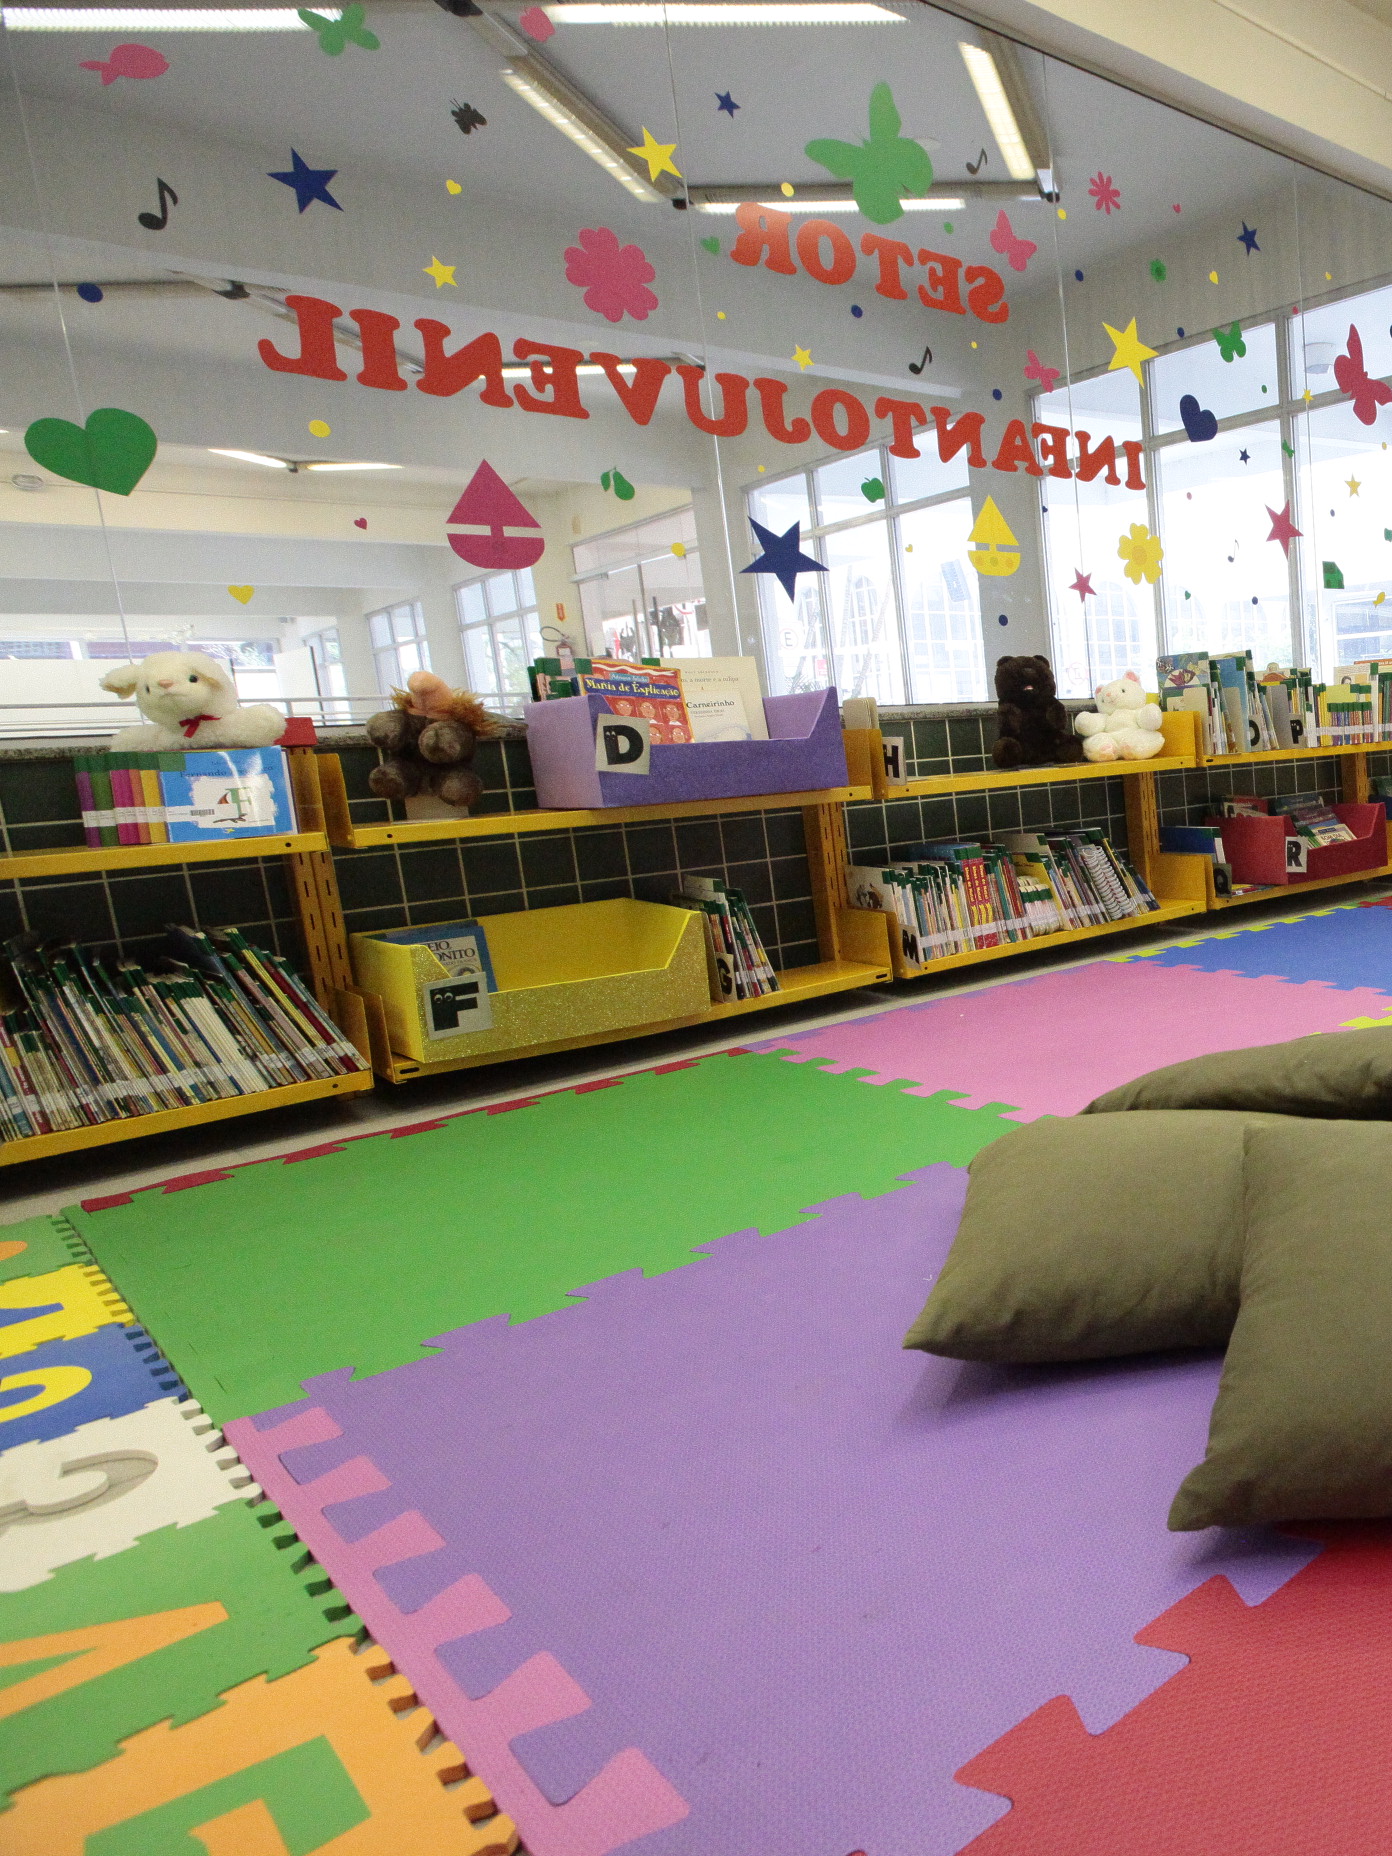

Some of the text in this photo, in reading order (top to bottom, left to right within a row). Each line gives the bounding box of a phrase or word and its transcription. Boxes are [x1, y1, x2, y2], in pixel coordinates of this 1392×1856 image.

[686, 700, 735, 709] Carneirinho
[602, 724, 644, 766] D
[1290, 719, 1304, 744] P
[882, 744, 900, 779] H
[1286, 840, 1303, 868] R
[716, 958, 733, 995] G
[430, 981, 480, 1032] F
